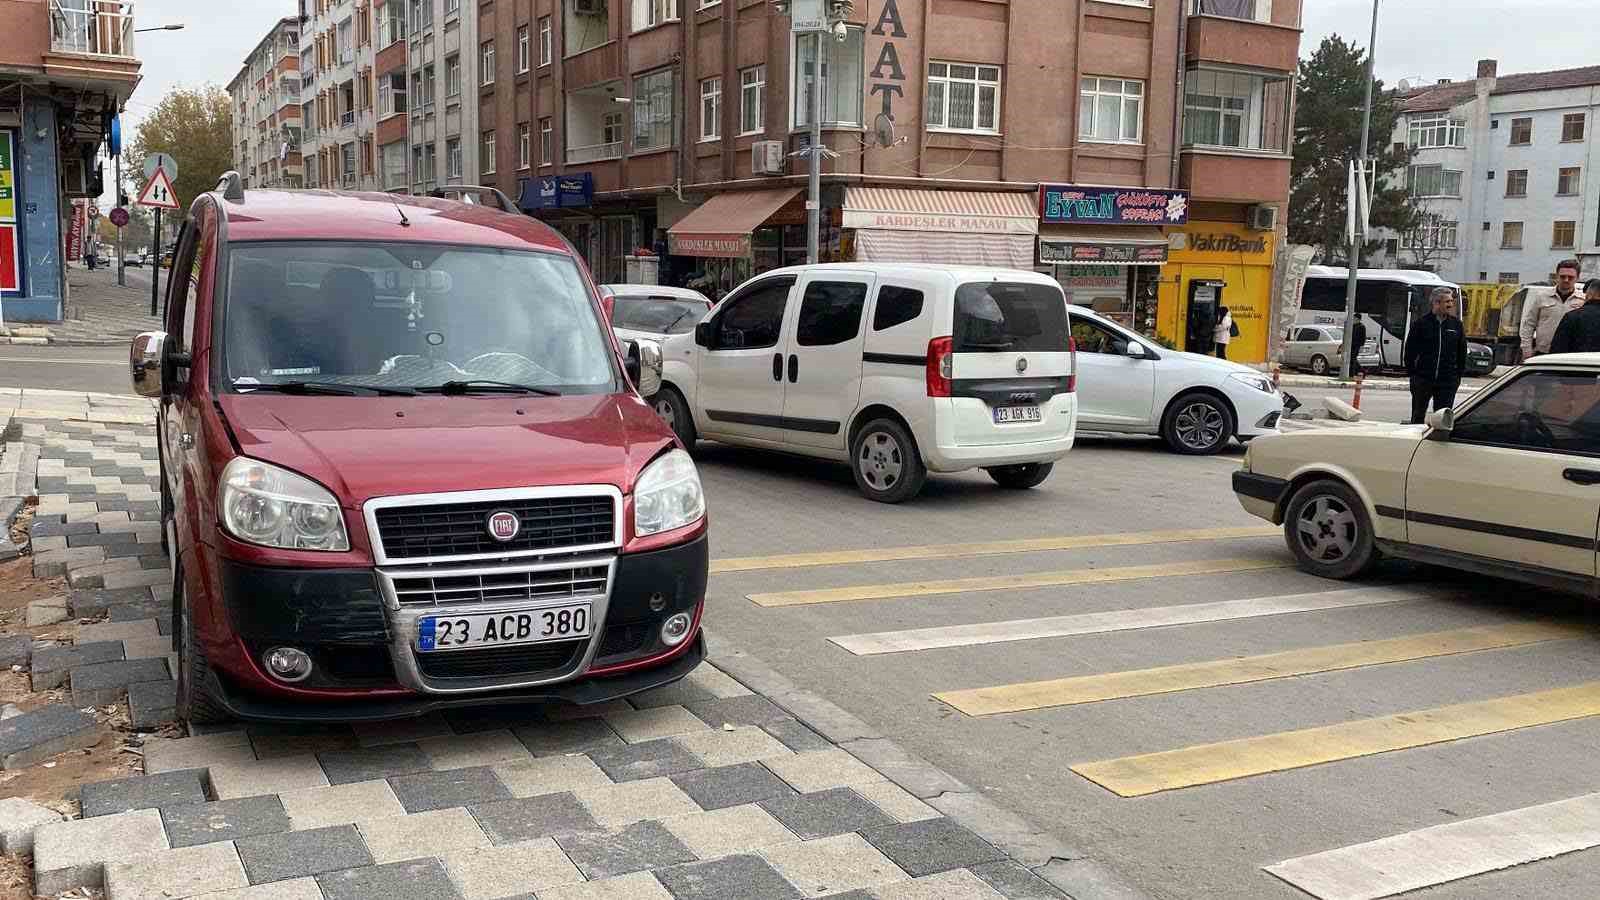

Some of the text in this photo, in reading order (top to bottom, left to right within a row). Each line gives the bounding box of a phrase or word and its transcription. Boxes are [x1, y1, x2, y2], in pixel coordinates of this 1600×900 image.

[1046, 191, 1116, 218] EYVAN
[960, 218, 1008, 230] MANAVI
[999, 407, 1040, 421] 23 AGK 916
[495, 519, 512, 533] FIAT
[438, 620, 470, 646] 23
[483, 614, 531, 642] ACB
[541, 608, 586, 635] 380
